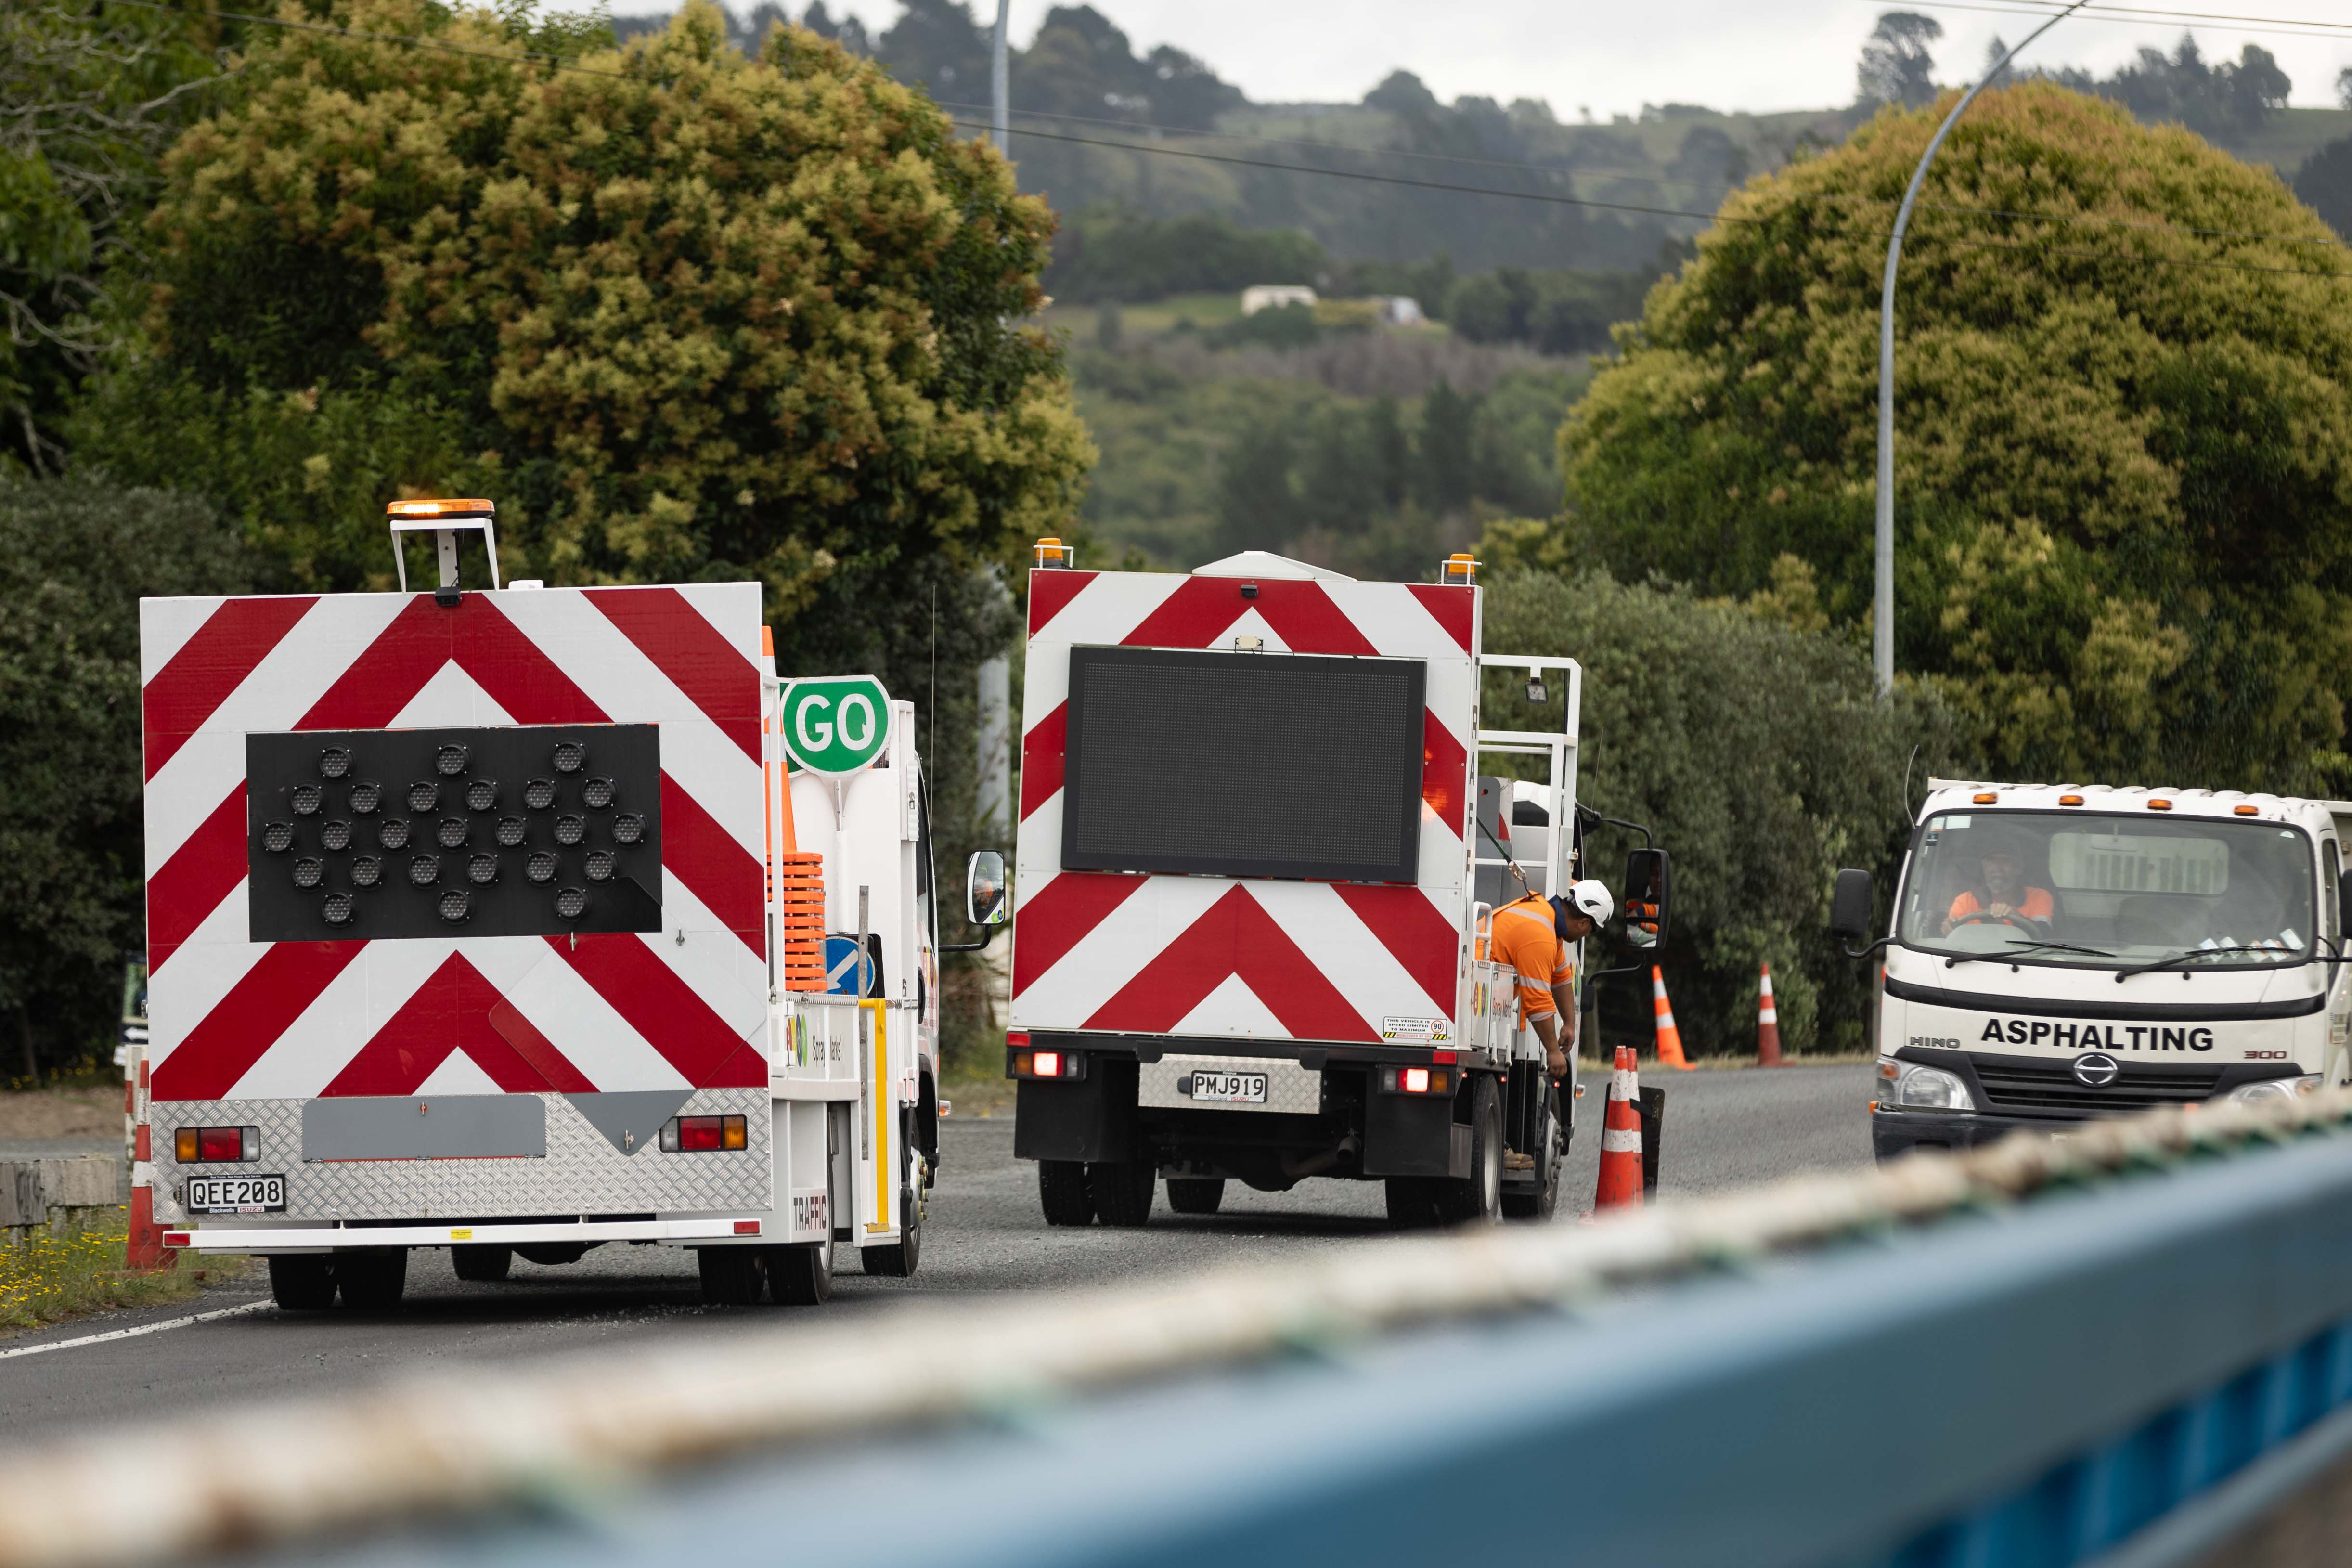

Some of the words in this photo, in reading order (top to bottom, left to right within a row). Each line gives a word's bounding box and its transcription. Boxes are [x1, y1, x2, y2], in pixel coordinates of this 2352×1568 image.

[796, 693, 876, 752] GO
[1910, 1036, 1961, 1049] HINO
[1980, 1019, 2214, 1052] ASPHALTING
[813, 1034, 825, 1067] Spray
[2243, 1050, 2288, 1060] 300
[1194, 1076, 1264, 1096] PMJ919
[193, 1181, 280, 1205] QEE208
[793, 1195, 827, 1231] TRAFFIC
